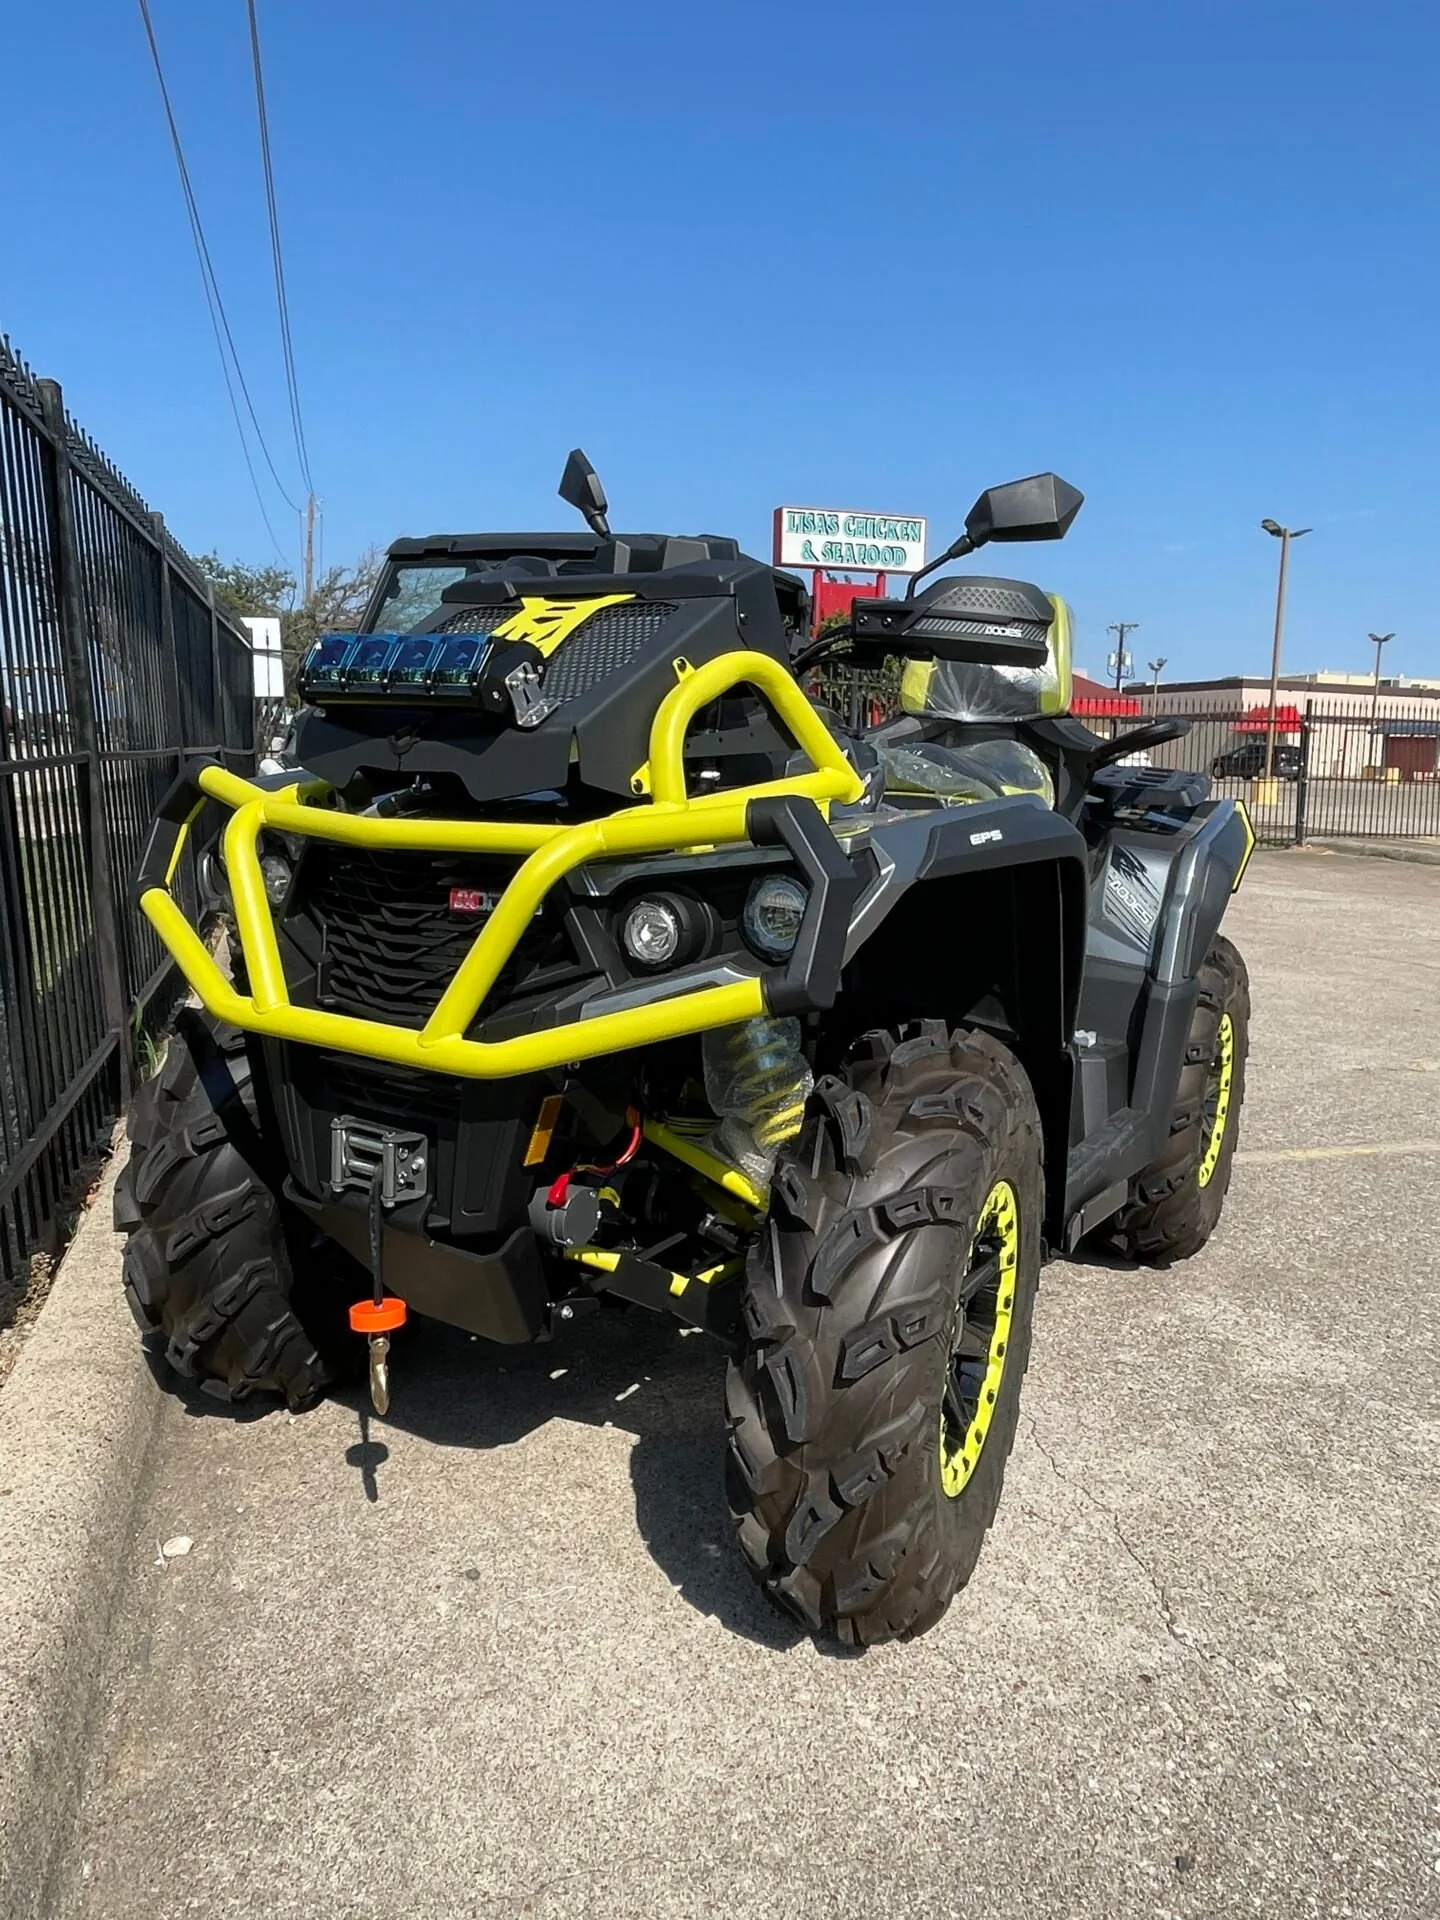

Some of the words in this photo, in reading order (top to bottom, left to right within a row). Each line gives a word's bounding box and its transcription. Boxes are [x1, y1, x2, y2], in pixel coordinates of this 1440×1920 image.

[844, 516, 922, 543] CHICKEN
[801, 540, 819, 562] &
[822, 542, 907, 567] SEAFOOD
[984, 625, 1023, 637] AODES
[969, 829, 1003, 846] EPS
[1109, 879, 1154, 924] AODES
